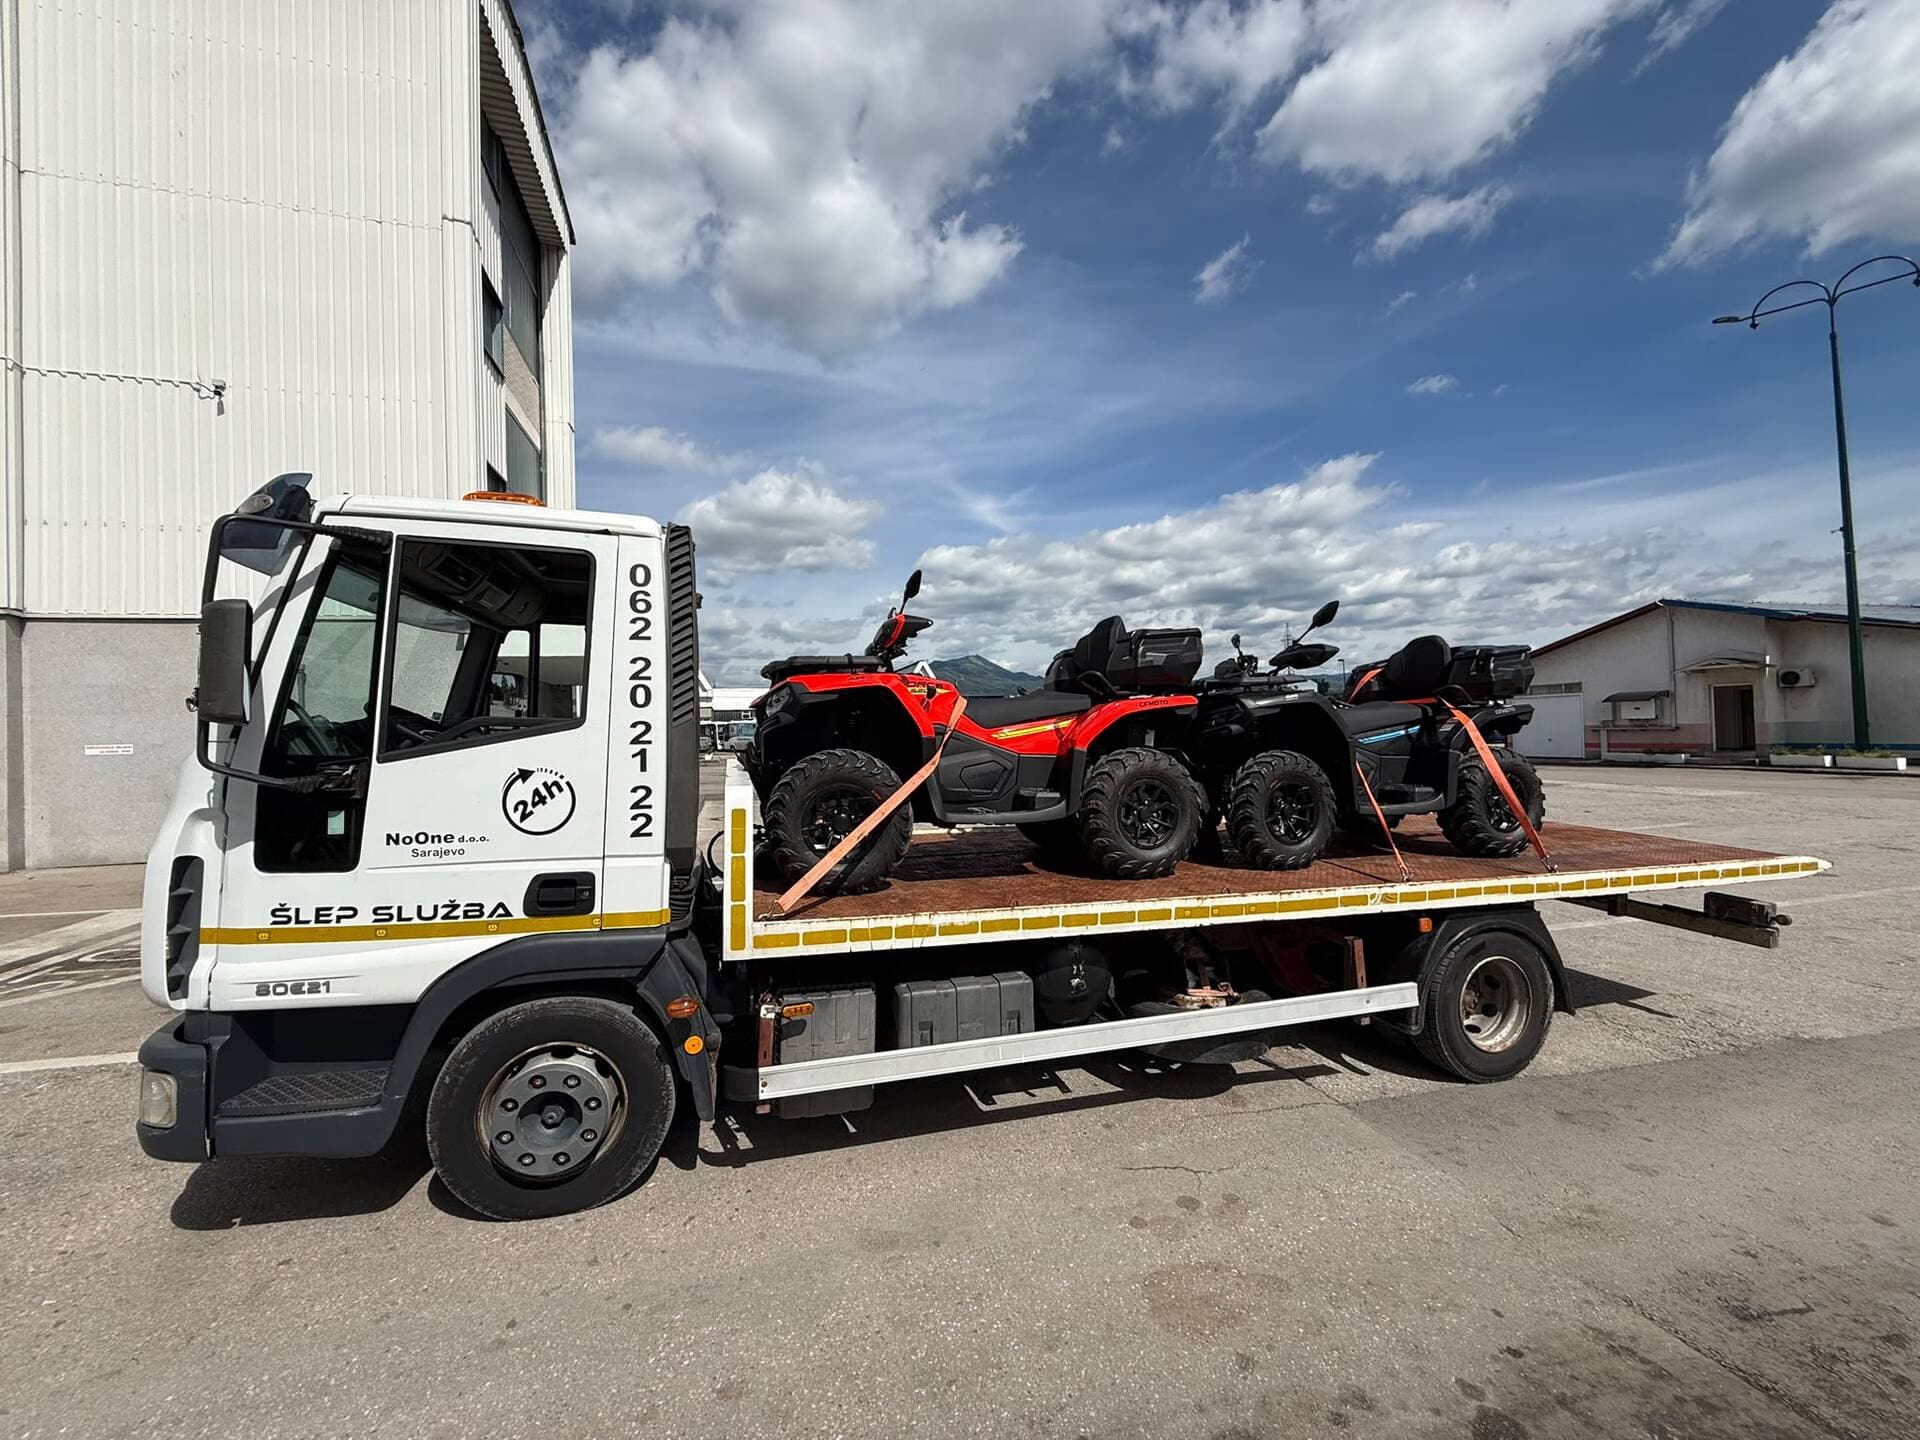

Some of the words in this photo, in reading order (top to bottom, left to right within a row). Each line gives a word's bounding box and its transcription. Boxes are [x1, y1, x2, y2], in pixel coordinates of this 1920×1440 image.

[629, 563, 652, 641] 062
[628, 656, 652, 708] 20
[629, 720, 653, 772] 21
[513, 779, 564, 823] 24h
[629, 785, 653, 838] 22
[385, 831, 456, 846] NoOne
[458, 834, 490, 844] d.o.o.
[411, 847, 465, 859] Sarajevo
[270, 902, 358, 926] ŠLEP
[372, 899, 514, 924] SLUŽBA
